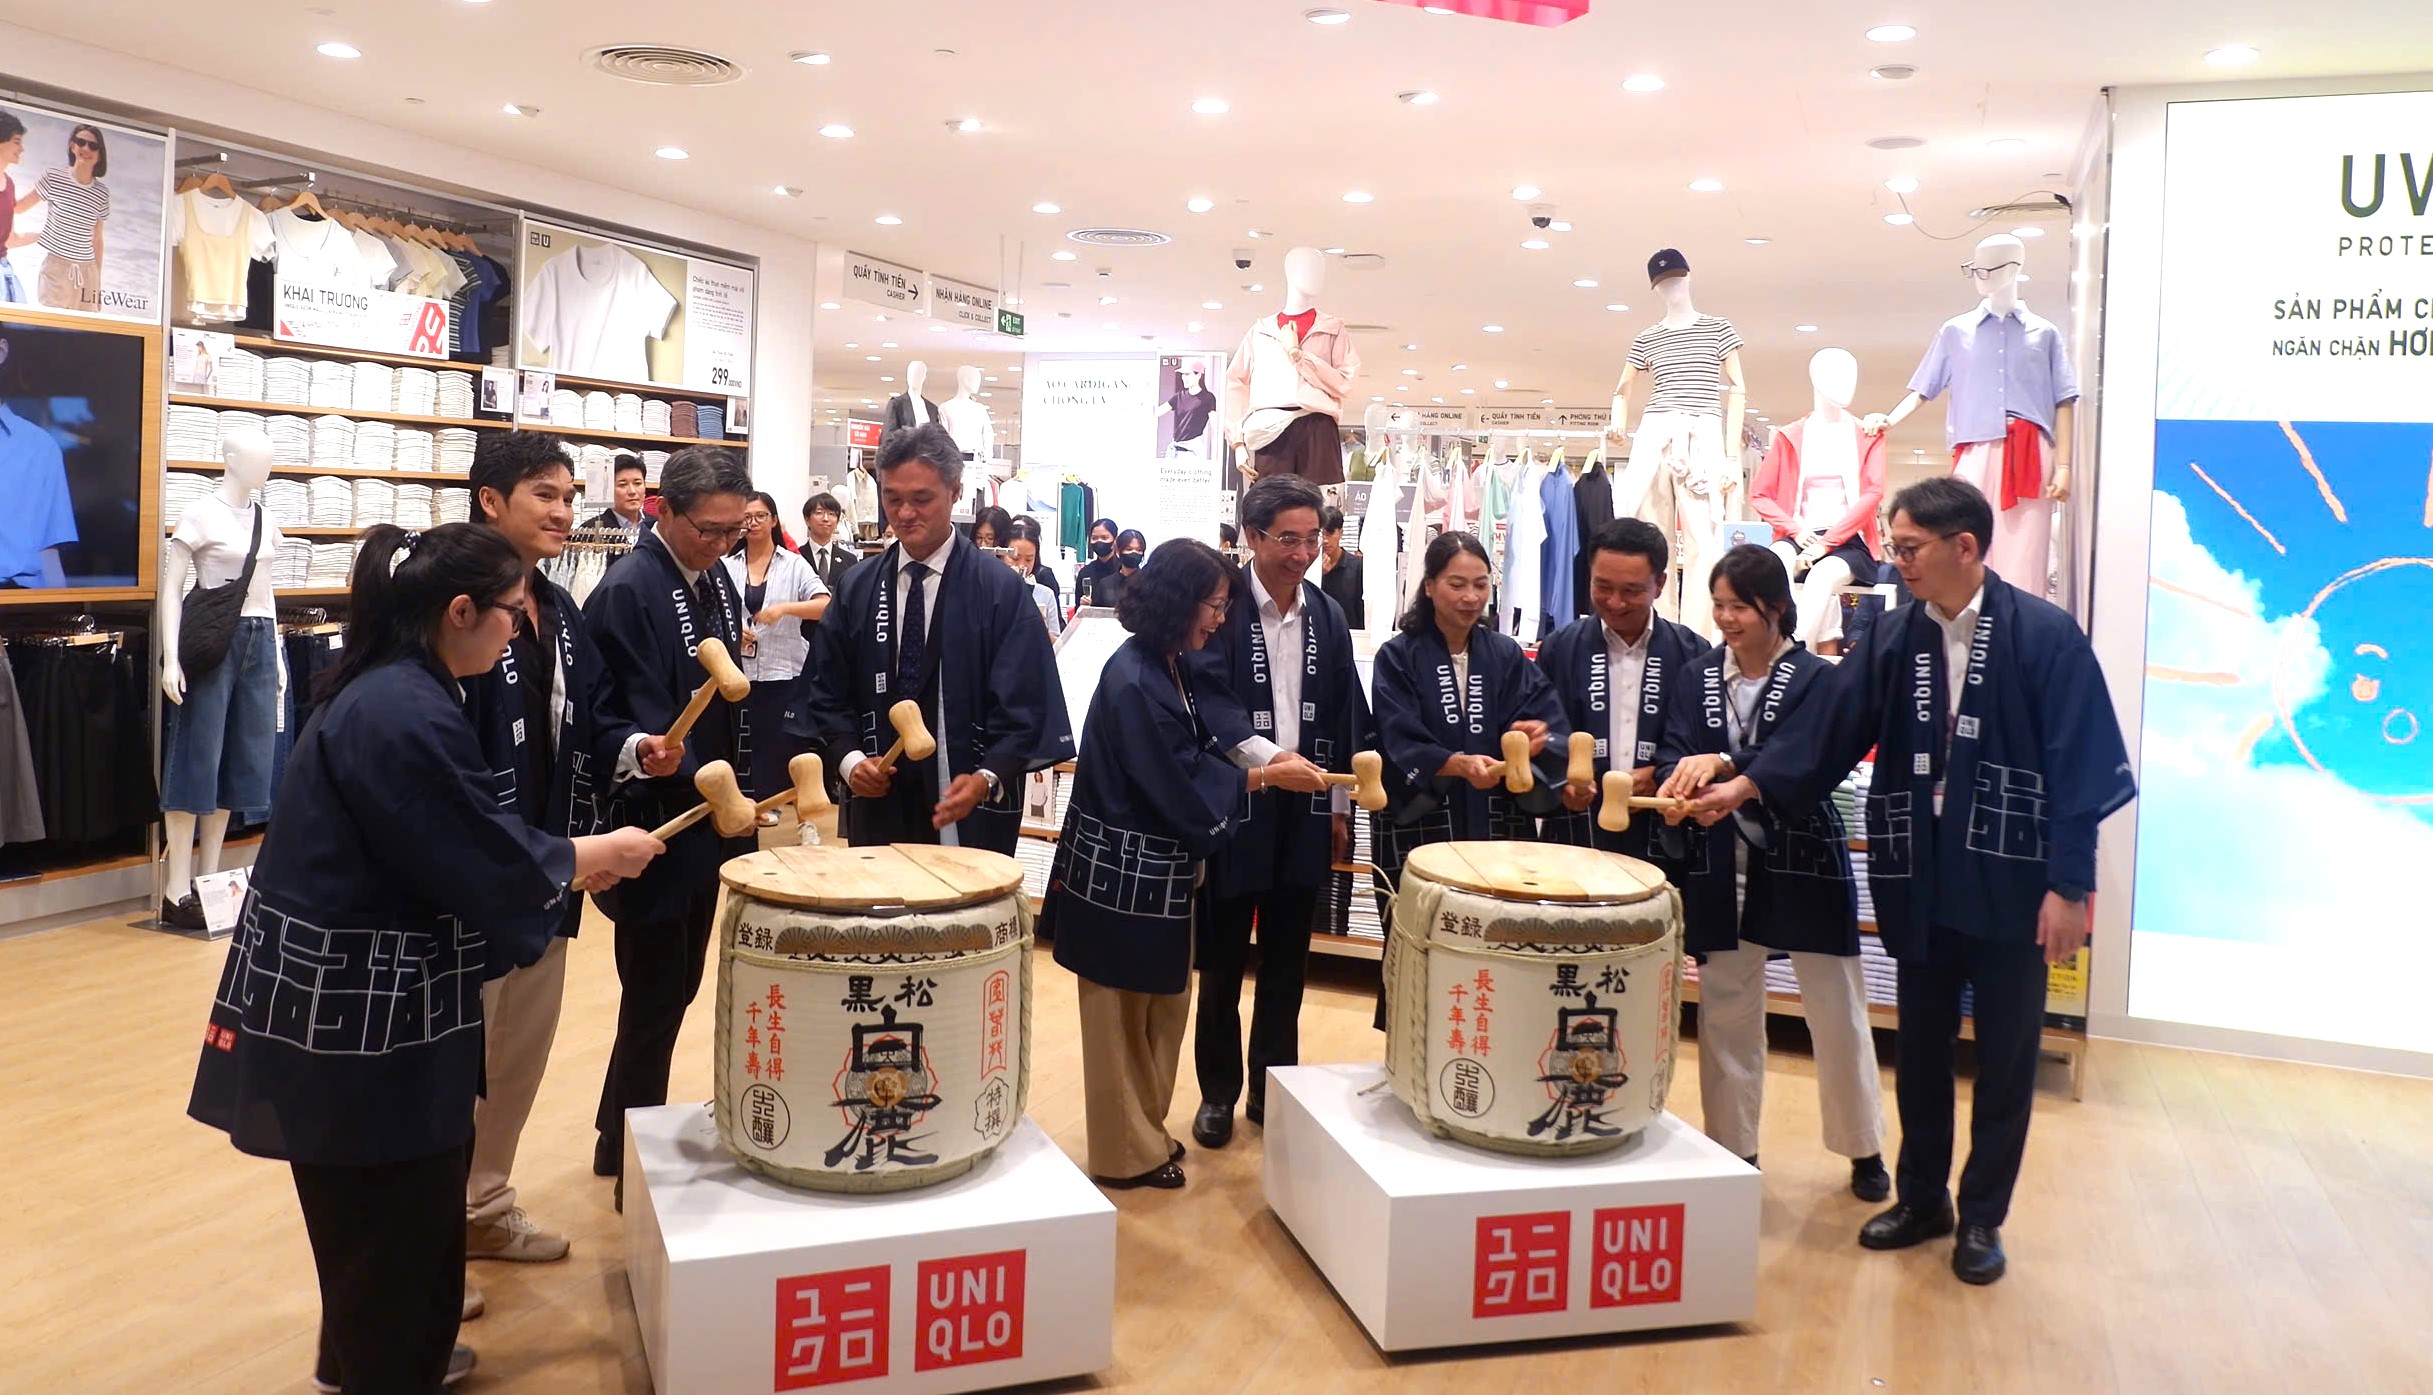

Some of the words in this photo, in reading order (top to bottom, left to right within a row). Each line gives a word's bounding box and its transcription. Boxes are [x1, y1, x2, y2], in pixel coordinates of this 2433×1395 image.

[81, 287, 149, 310] LifeWear
[284, 284, 314, 303] KHAI
[971, 296, 992, 311] ONLINE
[2274, 292, 2321, 320] SẢN
[2333, 288, 2402, 320] PHẨM
[2414, 297, 2433, 320] C
[2272, 336, 2322, 357] NGĂN
[2389, 327, 2433, 357] HƠ
[711, 366, 729, 386] 299
[1440, 412, 1462, 420] ONLINE
[672, 588, 698, 657] UNIQLO
[1250, 622, 1267, 684] UNIQLO
[1436, 664, 1459, 725] UNIQLO
[1467, 674, 1485, 735] UNIQLO
[1588, 653, 1606, 712] UNIQLO
[1642, 656, 1662, 715] UNIQLO
[1702, 666, 1723, 729] UNIQLO
[1762, 661, 1797, 722] UNIQLO
[1913, 652, 1931, 723] UNIQLO
[840, 975, 938, 1013] 黒松
[1549, 963, 1631, 998] 黒松
[1487, 1224, 1557, 1262] ユニ
[1602, 1216, 1668, 1255] UNI
[929, 1265, 1006, 1310] UNI
[1484, 1266, 1557, 1305] クロ
[1601, 1257, 1673, 1301] QLO
[792, 1281, 874, 1328] ユニ
[787, 1328, 874, 1376] クロ
[928, 1310, 1012, 1361] QLO
